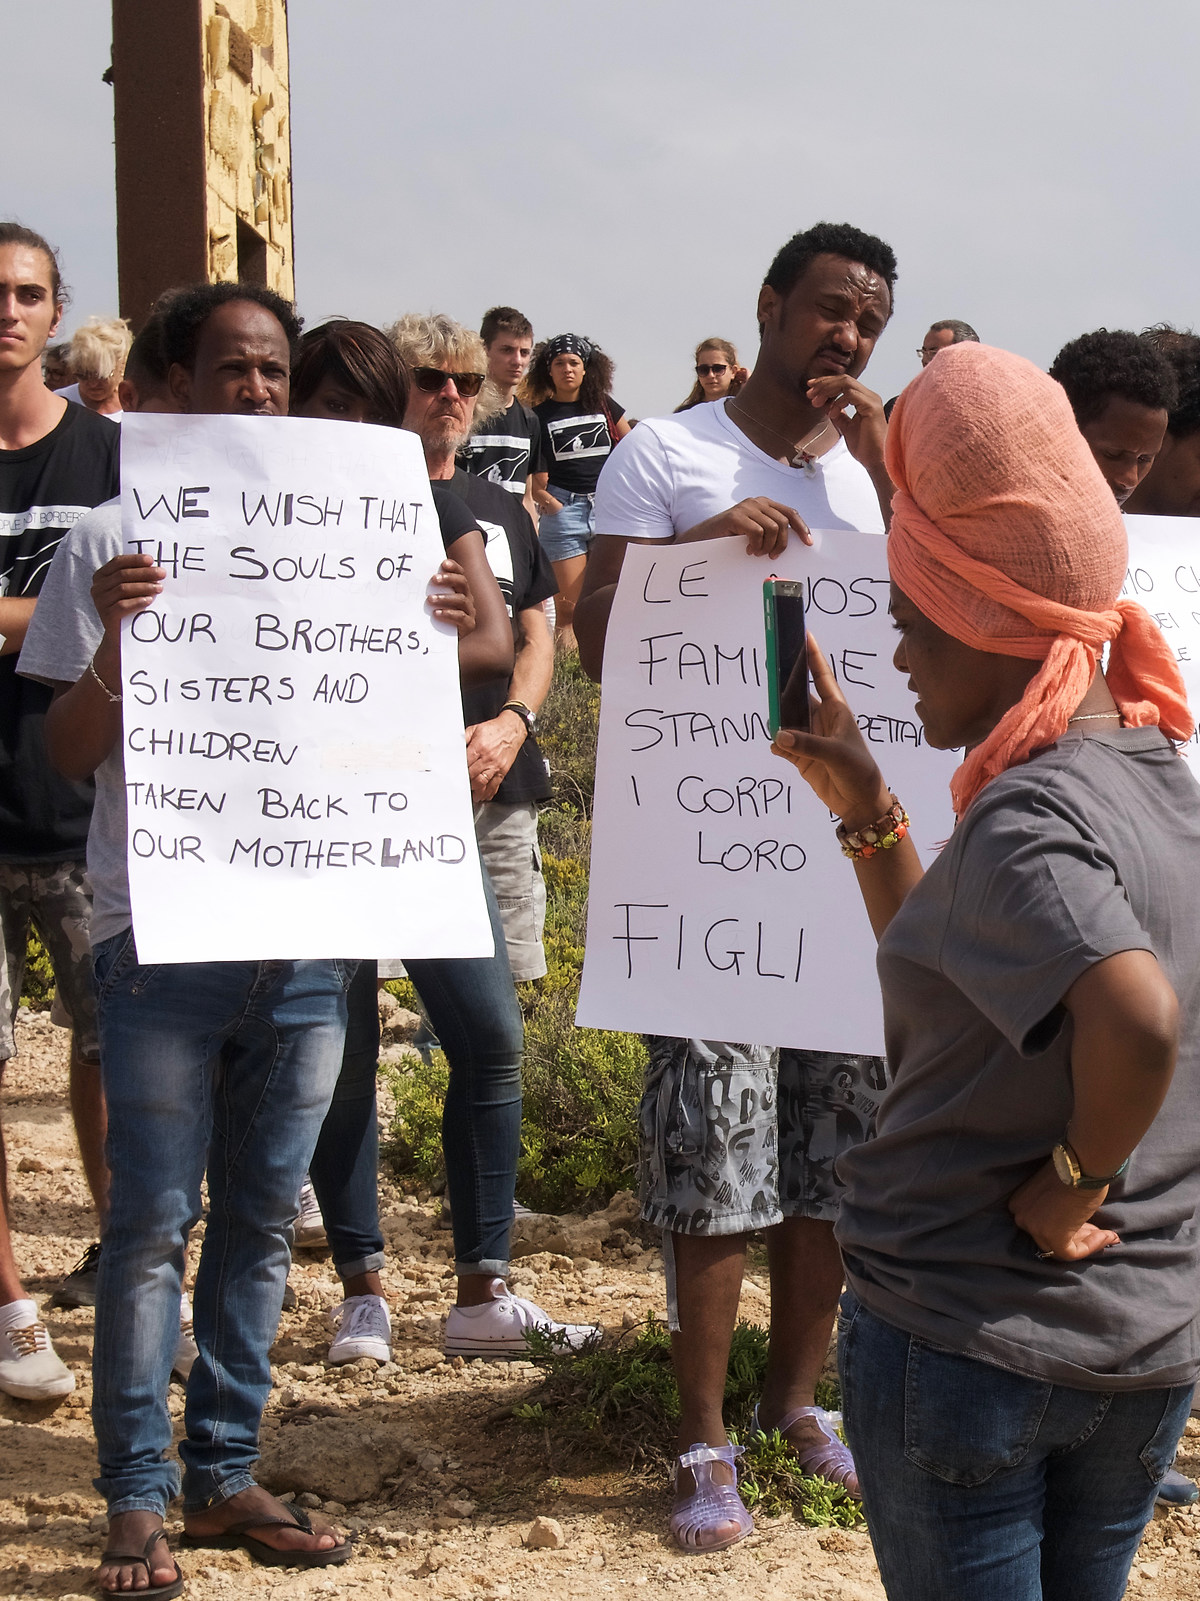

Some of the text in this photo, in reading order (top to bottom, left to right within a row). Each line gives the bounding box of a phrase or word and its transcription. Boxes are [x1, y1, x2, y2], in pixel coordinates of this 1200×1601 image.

[133, 486, 423, 535] WE WISH THAT
[128, 539, 413, 581] THE SOULS OF
[643, 560, 709, 604] LE
[131, 610, 429, 654] OUR BROTHERS,
[639, 632, 877, 689] FAMIIE
[129, 670, 369, 705] SISTERS AND
[129, 727, 298, 765] CHILDREN
[624, 708, 773, 752] STANN
[126, 782, 408, 819] TAKEN BACK TO
[631, 775, 792, 817] I CORPI
[133, 828, 466, 869] OUR MOTHERLAND
[698, 830, 807, 872] LORO
[612, 903, 804, 983] FIGLI
